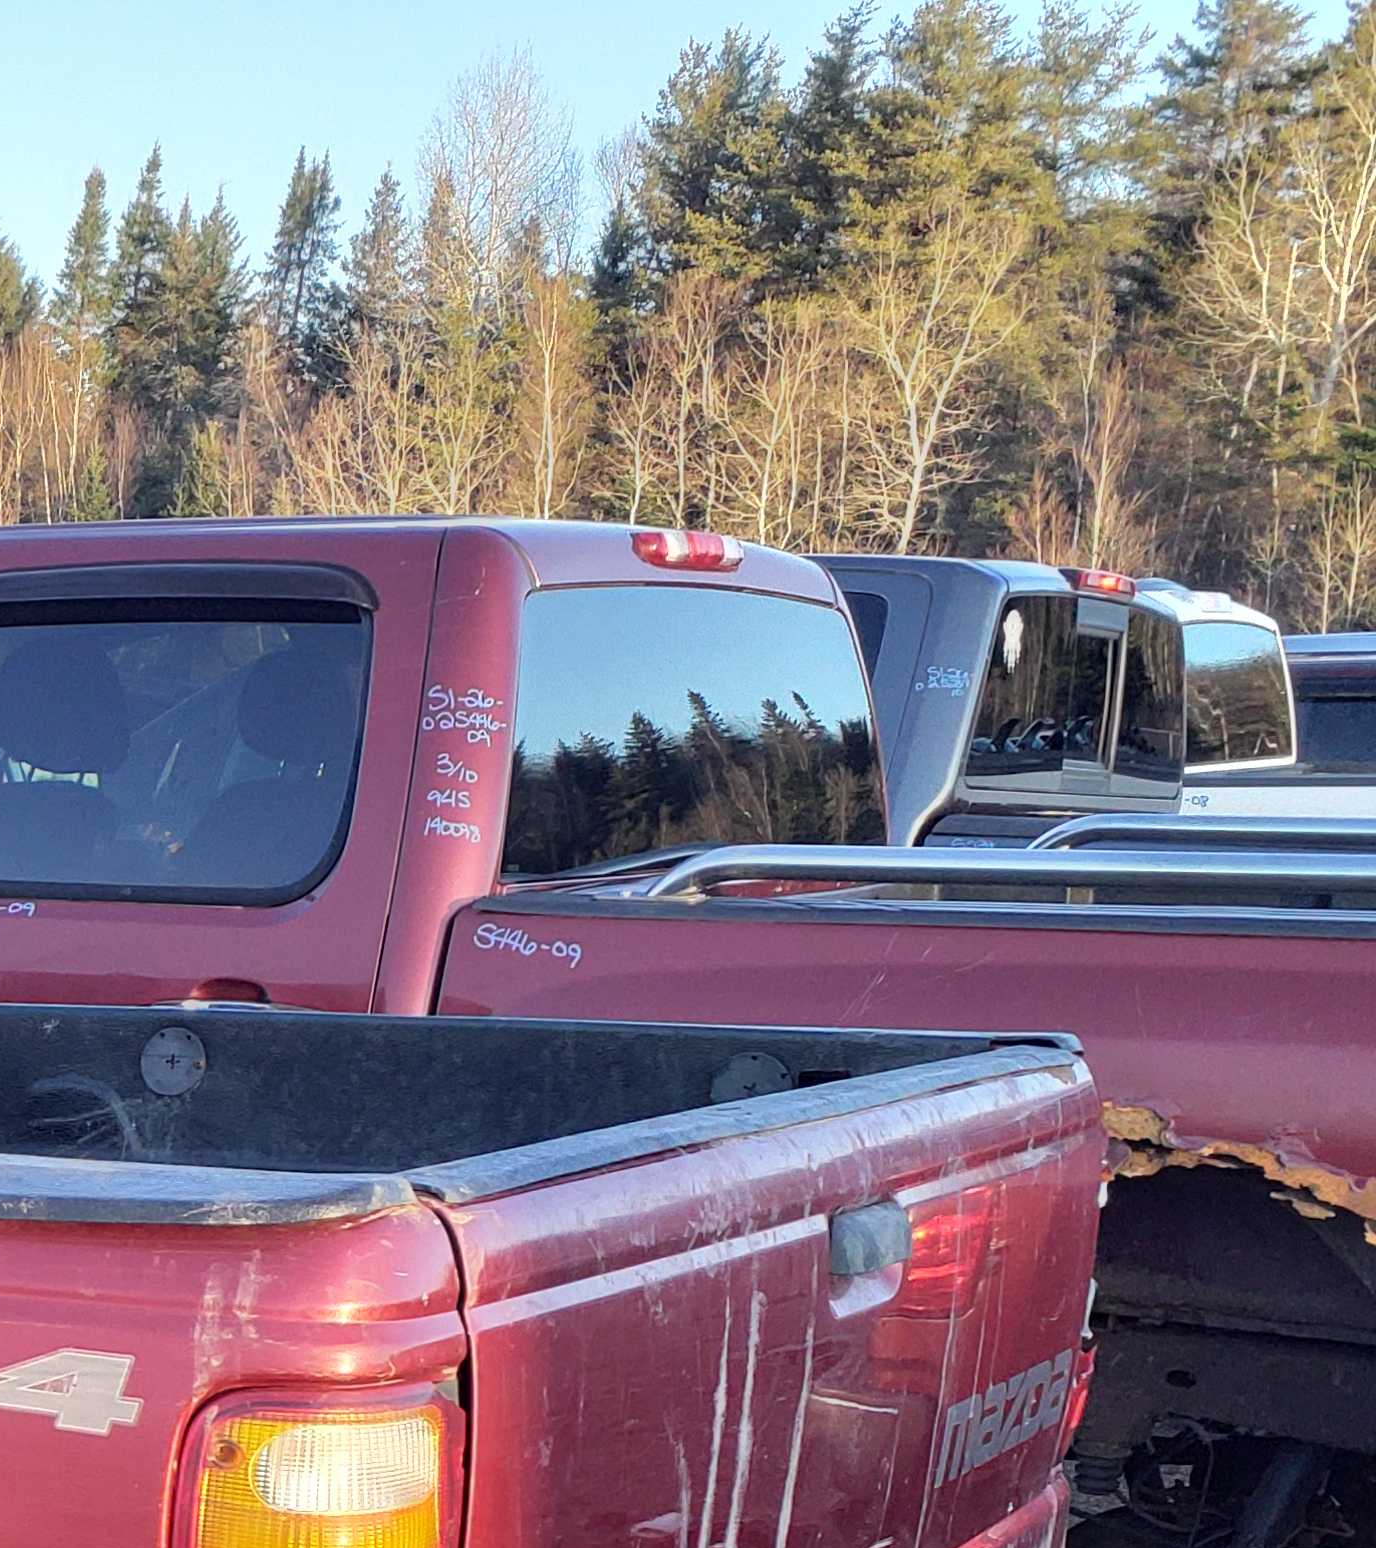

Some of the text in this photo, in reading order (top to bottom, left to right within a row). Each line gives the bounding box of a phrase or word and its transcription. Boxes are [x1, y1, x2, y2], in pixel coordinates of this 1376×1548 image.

[467, 729, 491, 748] 09
[436, 752, 479, 784] 3/10
[473, 923, 582, 969] S446-09
